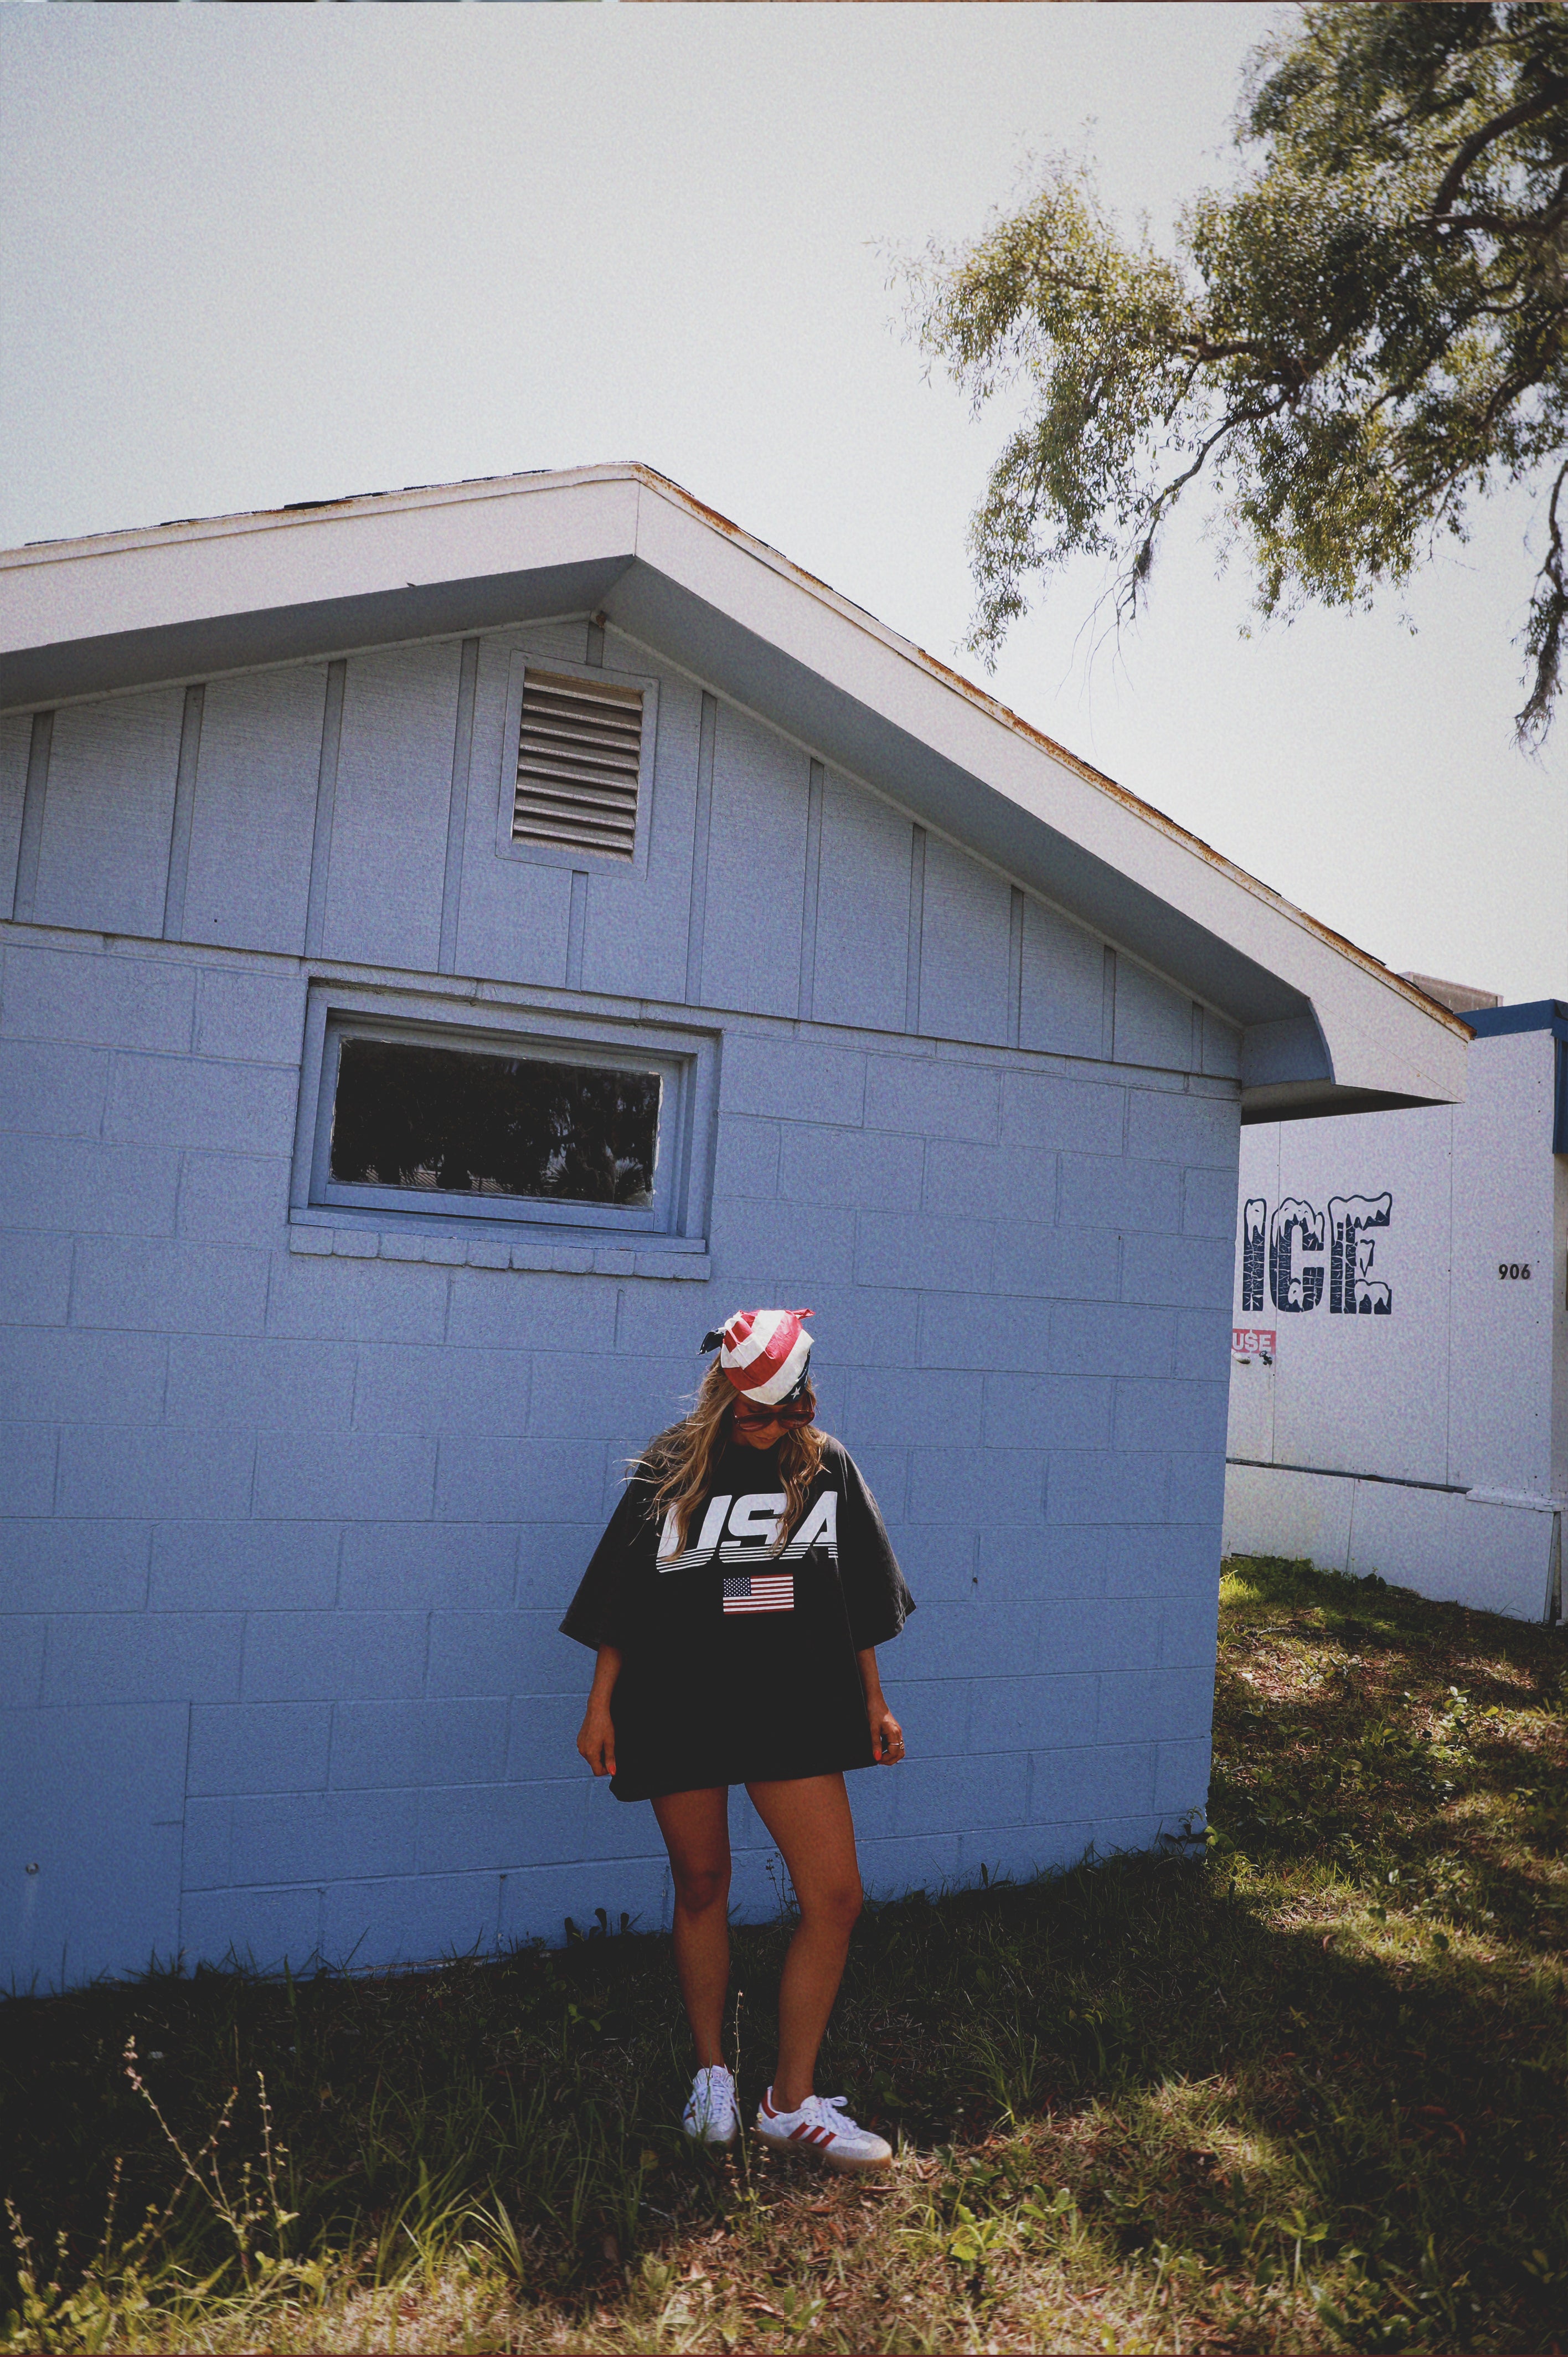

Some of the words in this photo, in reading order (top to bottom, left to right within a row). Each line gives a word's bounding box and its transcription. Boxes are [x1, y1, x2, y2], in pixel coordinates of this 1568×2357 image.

[1242, 1192, 1392, 1315] ICE
[1499, 1264, 1531, 1280] 906
[656, 1491, 838, 1573] USA
